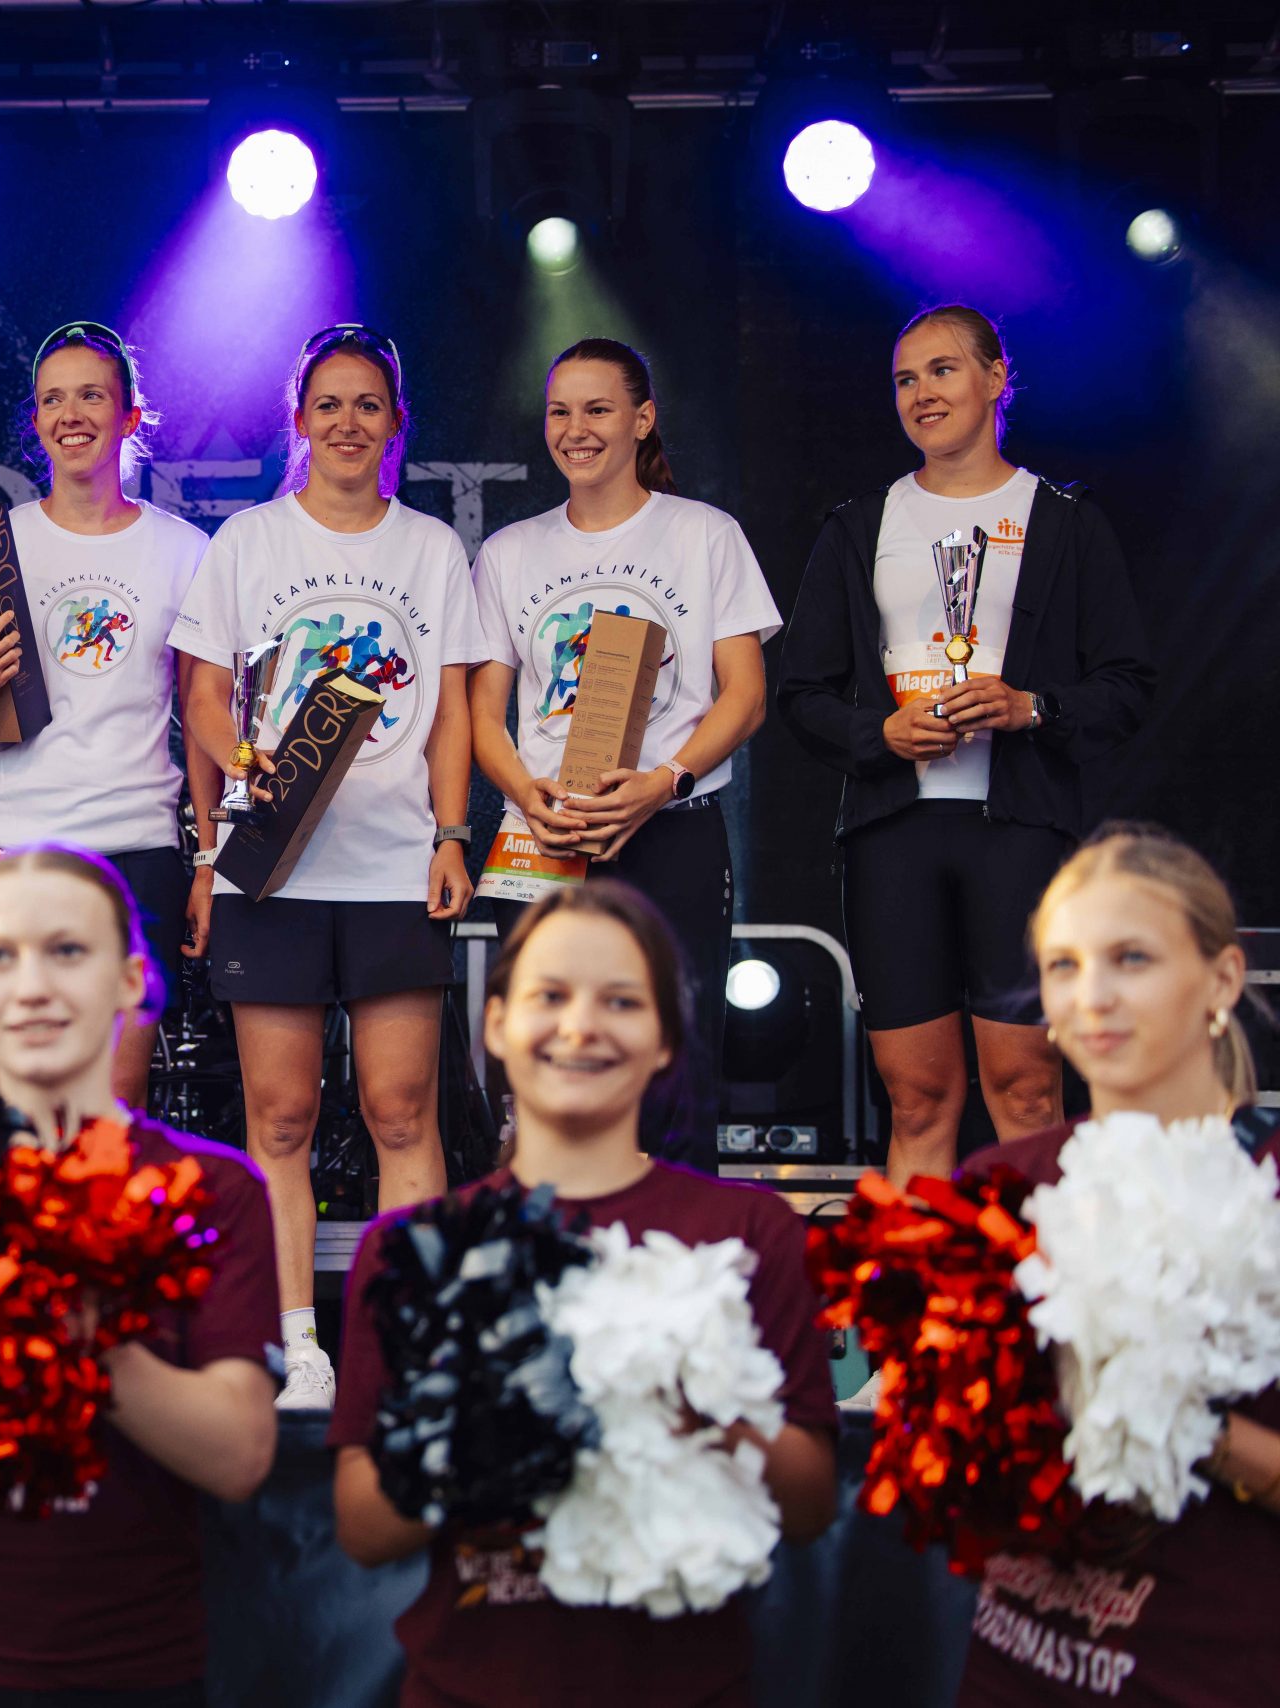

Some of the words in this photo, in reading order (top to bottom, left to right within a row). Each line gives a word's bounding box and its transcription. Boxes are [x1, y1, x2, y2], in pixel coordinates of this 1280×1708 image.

[39, 574, 141, 607] #TEAMKLINIKUM
[260, 573, 431, 637] #TEAMKLINIKUM
[517, 565, 689, 634] #TEAMKLINIKUM
[510, 858, 531, 869] 4778
[500, 879, 516, 887] AOK
